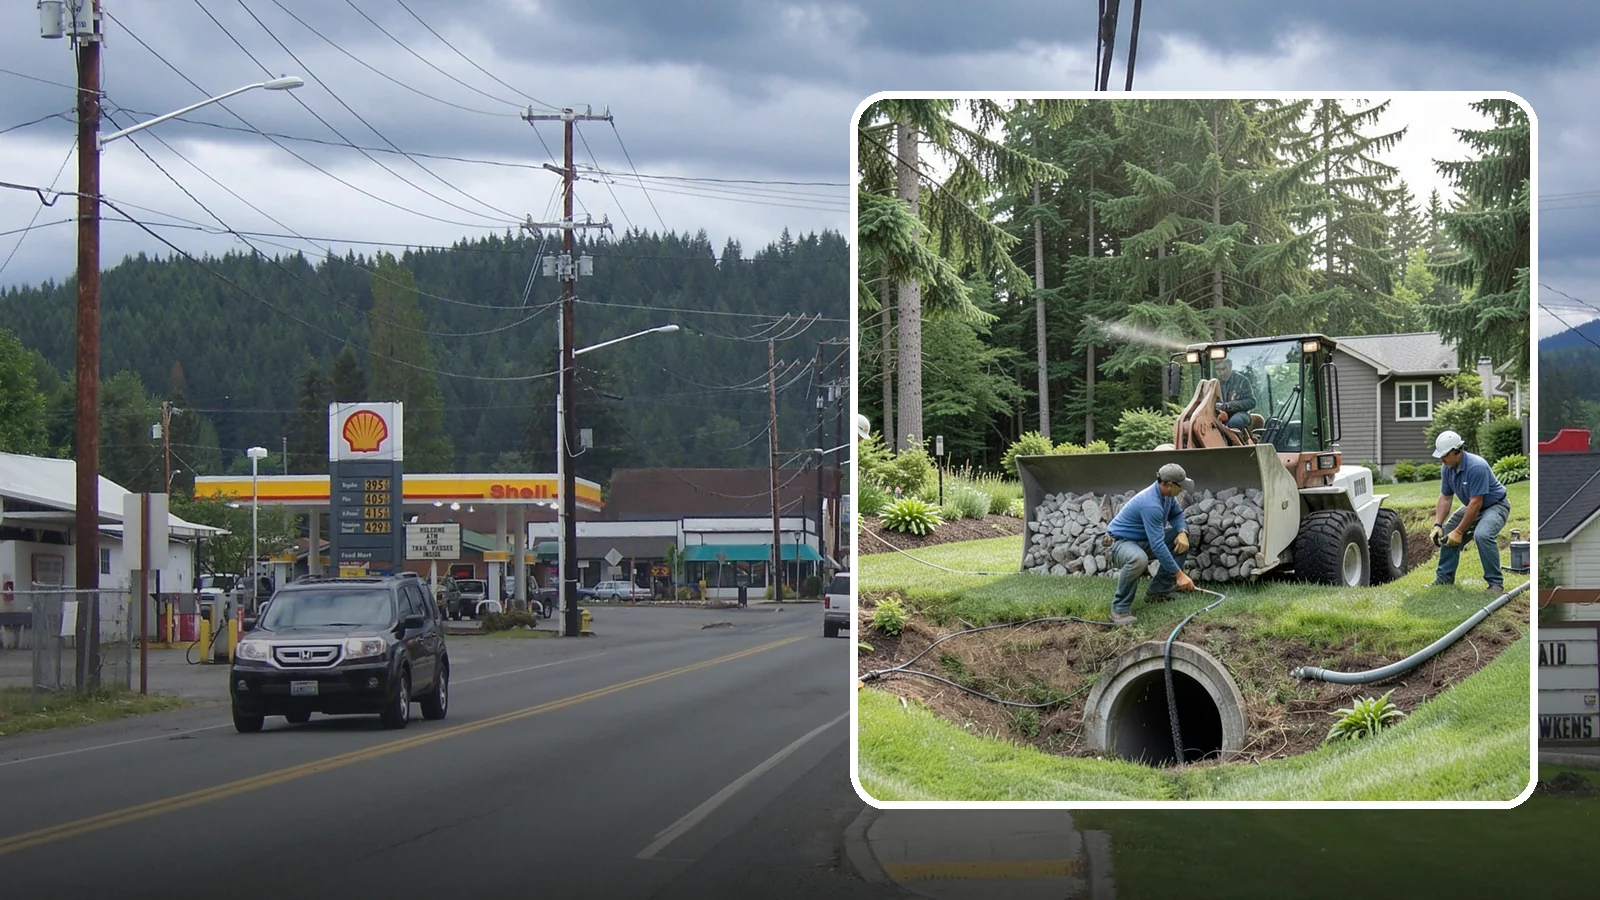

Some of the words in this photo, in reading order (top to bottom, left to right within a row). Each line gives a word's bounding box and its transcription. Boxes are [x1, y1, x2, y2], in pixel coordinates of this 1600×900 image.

[366, 480, 383, 490] 395
[490, 484, 547, 499] Shell
[366, 494, 383, 504] 405
[366, 508, 383, 518] 415
[366, 522, 383, 532] 429
[1538, 643, 1566, 665] AID
[1538, 715, 1592, 738] WKENS
